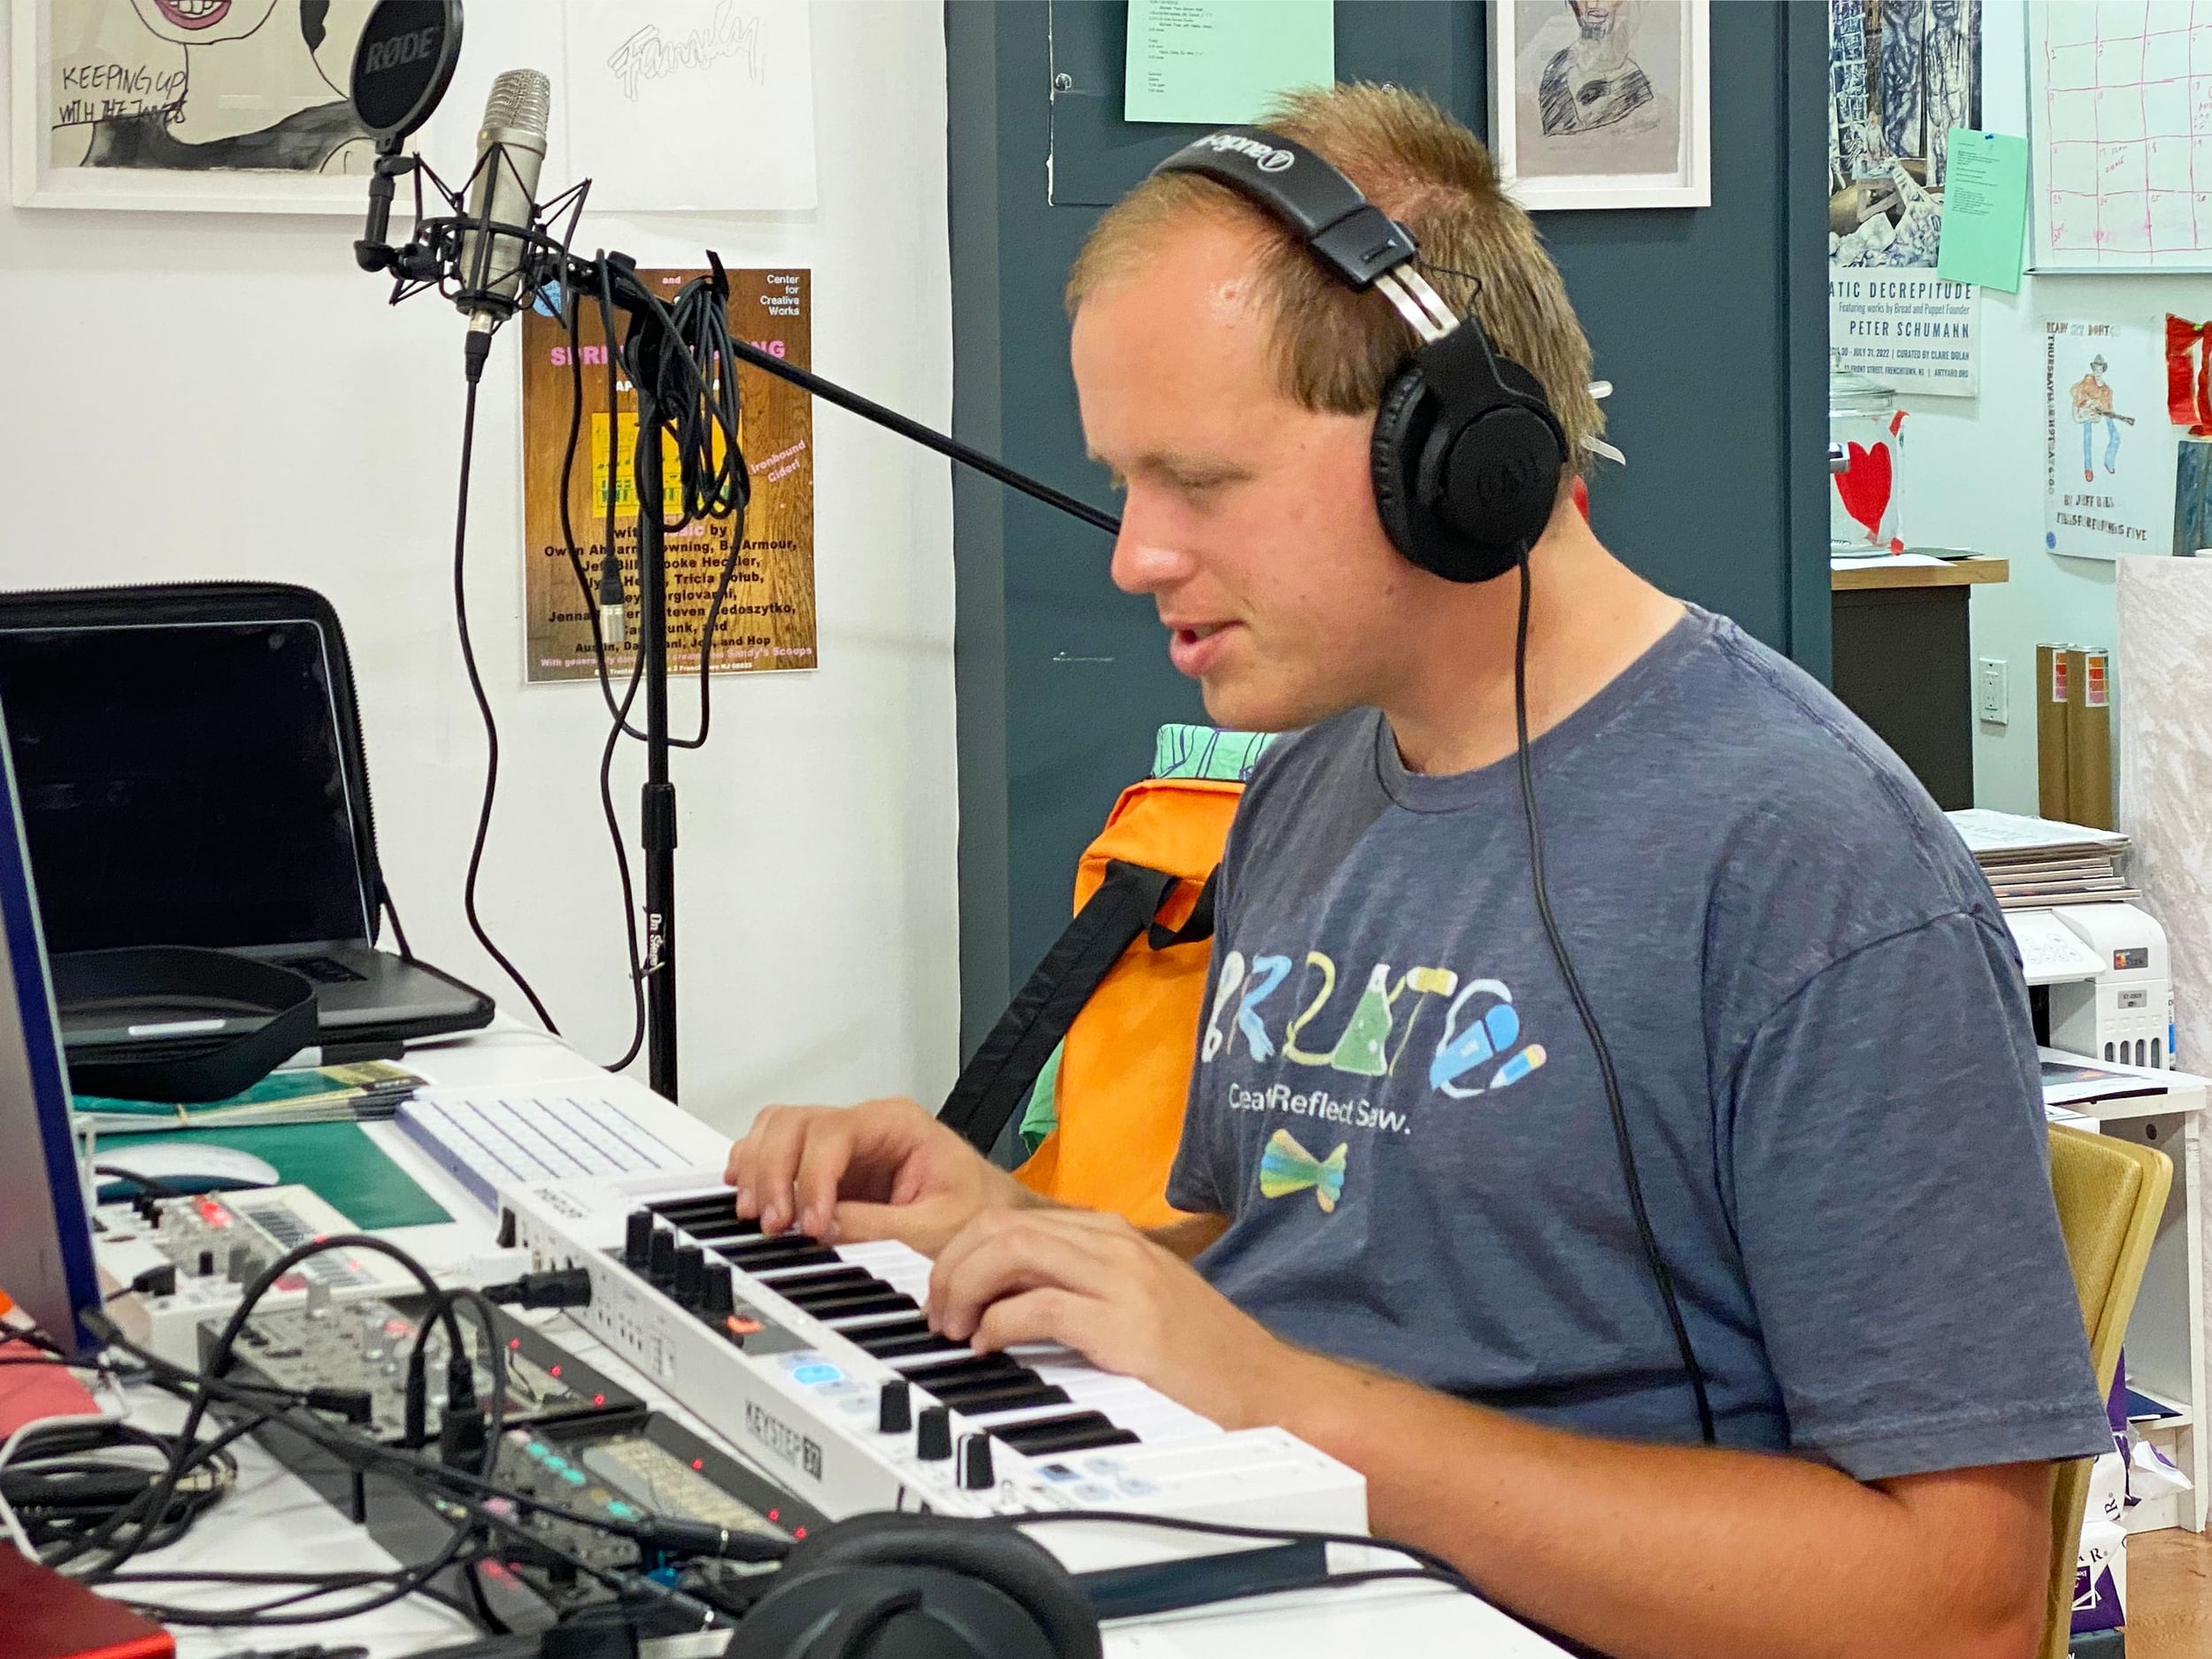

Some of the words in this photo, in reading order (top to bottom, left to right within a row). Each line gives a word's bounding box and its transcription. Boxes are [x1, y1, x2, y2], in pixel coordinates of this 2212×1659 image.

[365, 25, 435, 76] RØDE
[63, 65, 152, 95] KEEPING
[155, 71, 187, 99] UP
[662, 276, 681, 285] and
[766, 274, 801, 285] Center
[785, 286, 801, 295] for
[1870, 281, 1972, 300] DECREPITUDE
[759, 296, 801, 306] Creative
[768, 306, 801, 317] Works
[1839, 301, 1867, 316] Featuring
[1867, 303, 1886, 314] works
[1886, 303, 1894, 316] by
[1894, 303, 1913, 315] Bread
[1913, 303, 1924, 315] and
[1924, 303, 1947, 319] Puppet
[1947, 303, 1970, 316] Founder
[1849, 320, 1890, 336] PETER
[1897, 321, 1970, 339] SCHUMANN
[1854, 348, 1866, 357] JULY
[1876, 349, 1890, 358] 2022
[1897, 349, 1922, 359] CURATED
[1923, 350, 1930, 360] BY
[1931, 350, 1950, 361] CLARE
[749, 440, 807, 474] Ironbound
[710, 524, 727, 537] by
[544, 546, 584, 557] Own
[741, 540, 797, 551] Armour,
[702, 556, 761, 568] Hecler,
[674, 573, 715, 584] Tricia
[666, 603, 705, 617] teven
[718, 603, 796, 617] edoszytko,
[576, 640, 619, 653] Ausin,
[720, 636, 744, 647] and
[747, 635, 772, 647] Hop
[726, 647, 770, 659] Sandy's
[772, 646, 812, 657] Scoops
